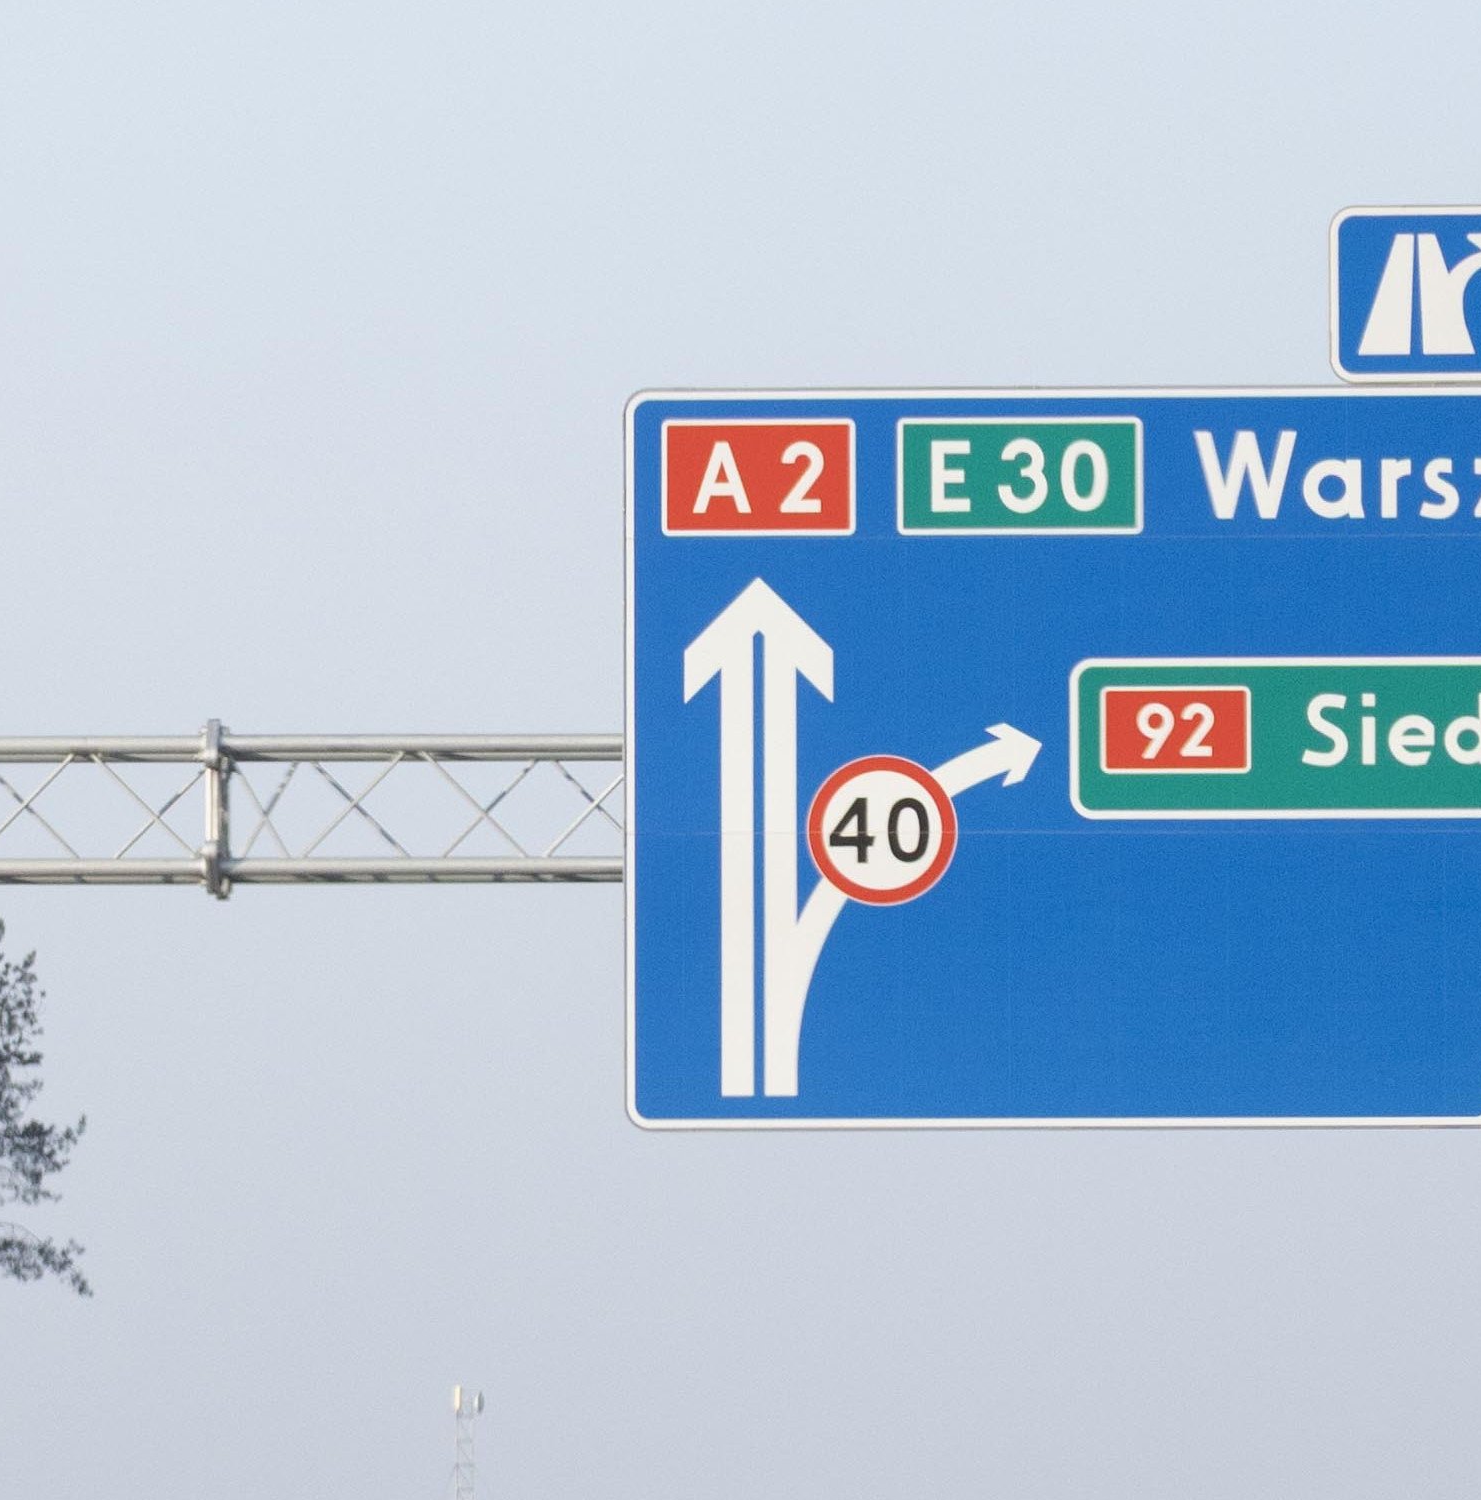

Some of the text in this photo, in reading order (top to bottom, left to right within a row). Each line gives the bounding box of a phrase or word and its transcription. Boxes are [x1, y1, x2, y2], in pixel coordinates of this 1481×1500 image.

[692, 440, 825, 515] A 2
[929, 437, 1110, 515] E 30
[1135, 701, 1216, 760] 92
[828, 796, 930, 864] 40
